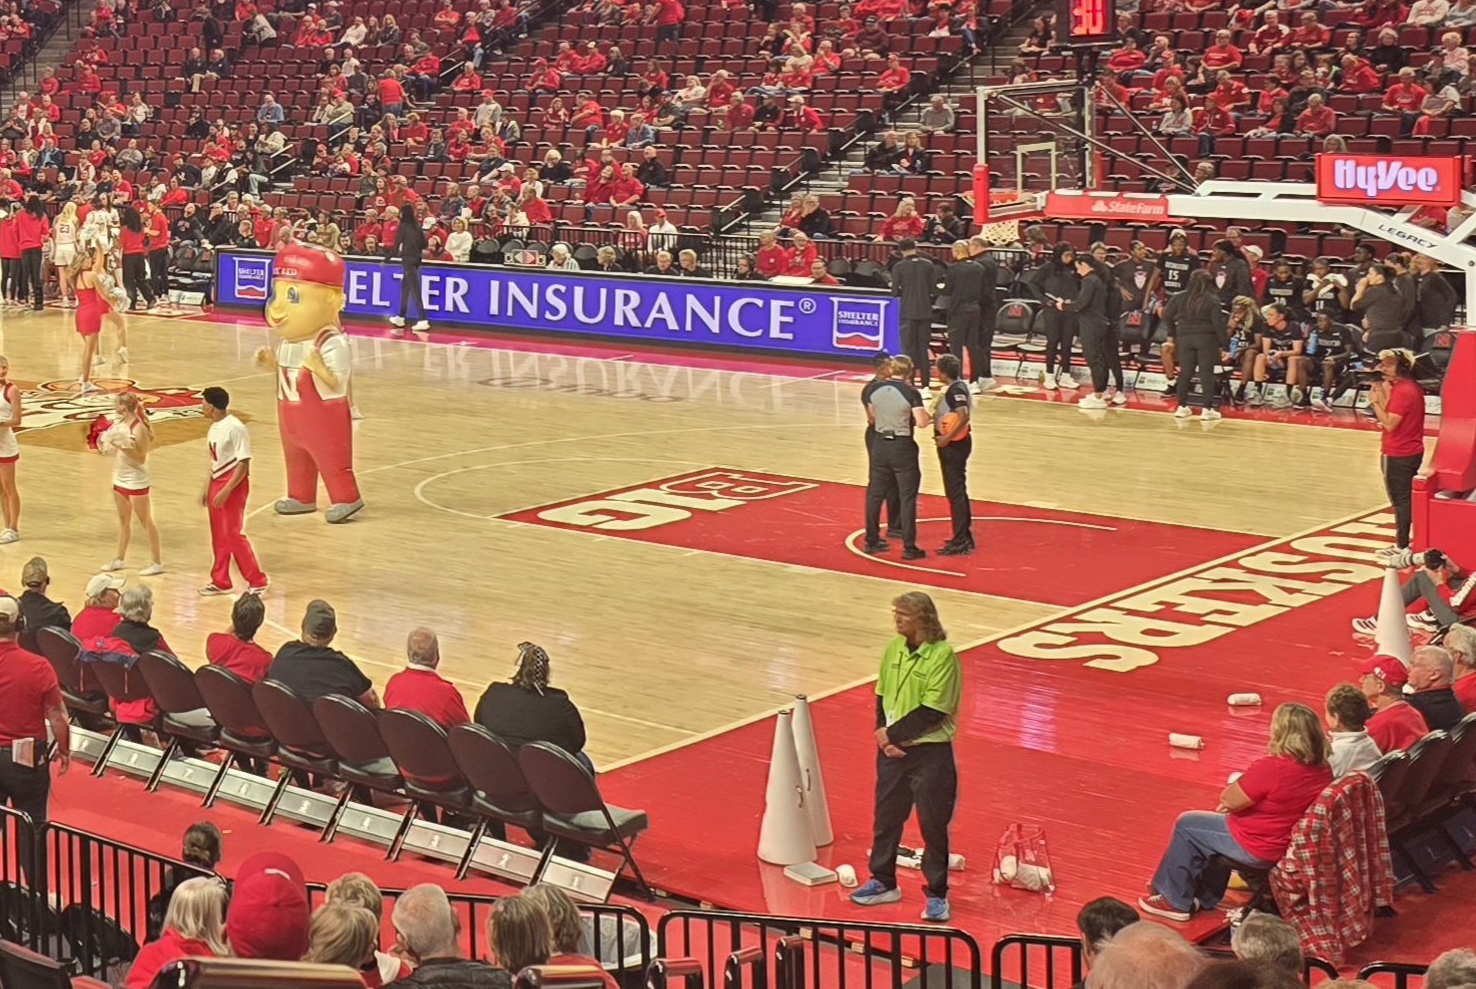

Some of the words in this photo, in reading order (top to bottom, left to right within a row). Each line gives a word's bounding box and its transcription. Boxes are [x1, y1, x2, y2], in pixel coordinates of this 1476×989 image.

[1334, 159, 1438, 196] HyVee
[1377, 223, 1439, 249] LEGACY
[349, 270, 470, 313] ELER
[838, 311, 879, 321] SHELTER
[278, 367, 300, 402] N
